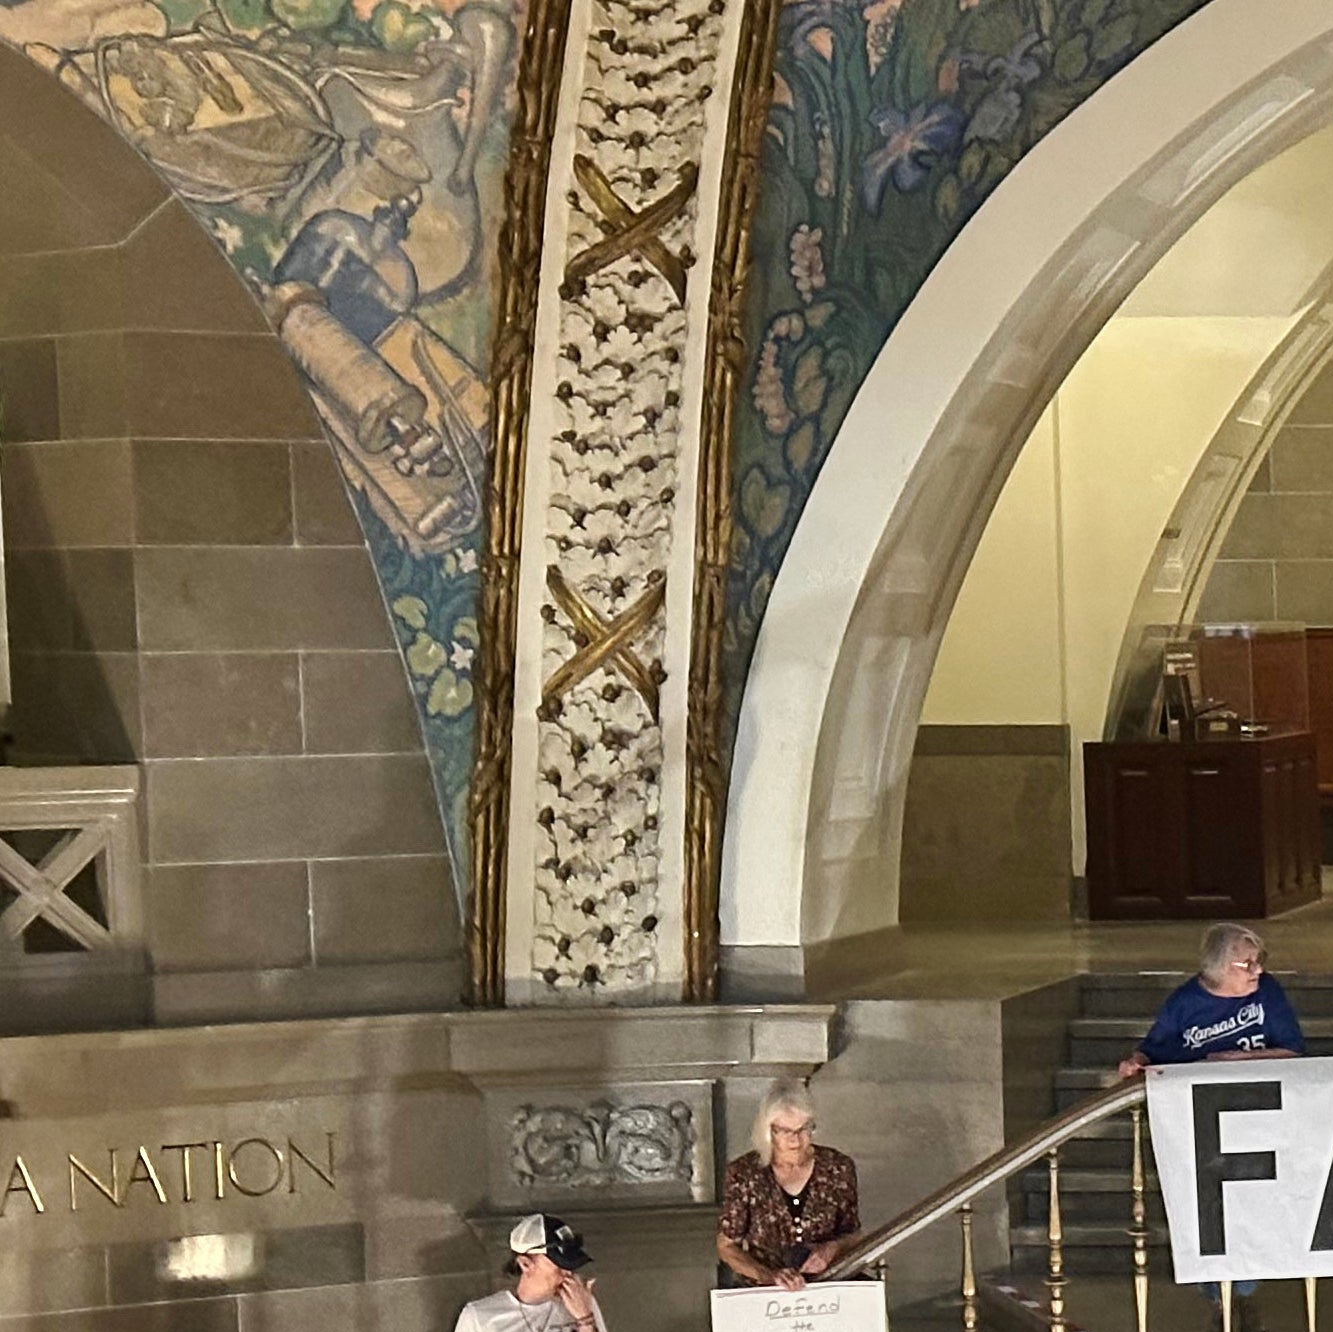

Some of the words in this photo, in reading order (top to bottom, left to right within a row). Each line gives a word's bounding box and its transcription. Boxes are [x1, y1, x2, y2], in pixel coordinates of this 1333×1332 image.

[1183, 1017, 1236, 1049] Kansas
[1237, 1003, 1265, 1026] City
[0, 1154, 45, 1217] A
[68, 1131, 338, 1213] NATION
[765, 1296, 840, 1319] Defend
[791, 1320, 815, 1332] the
